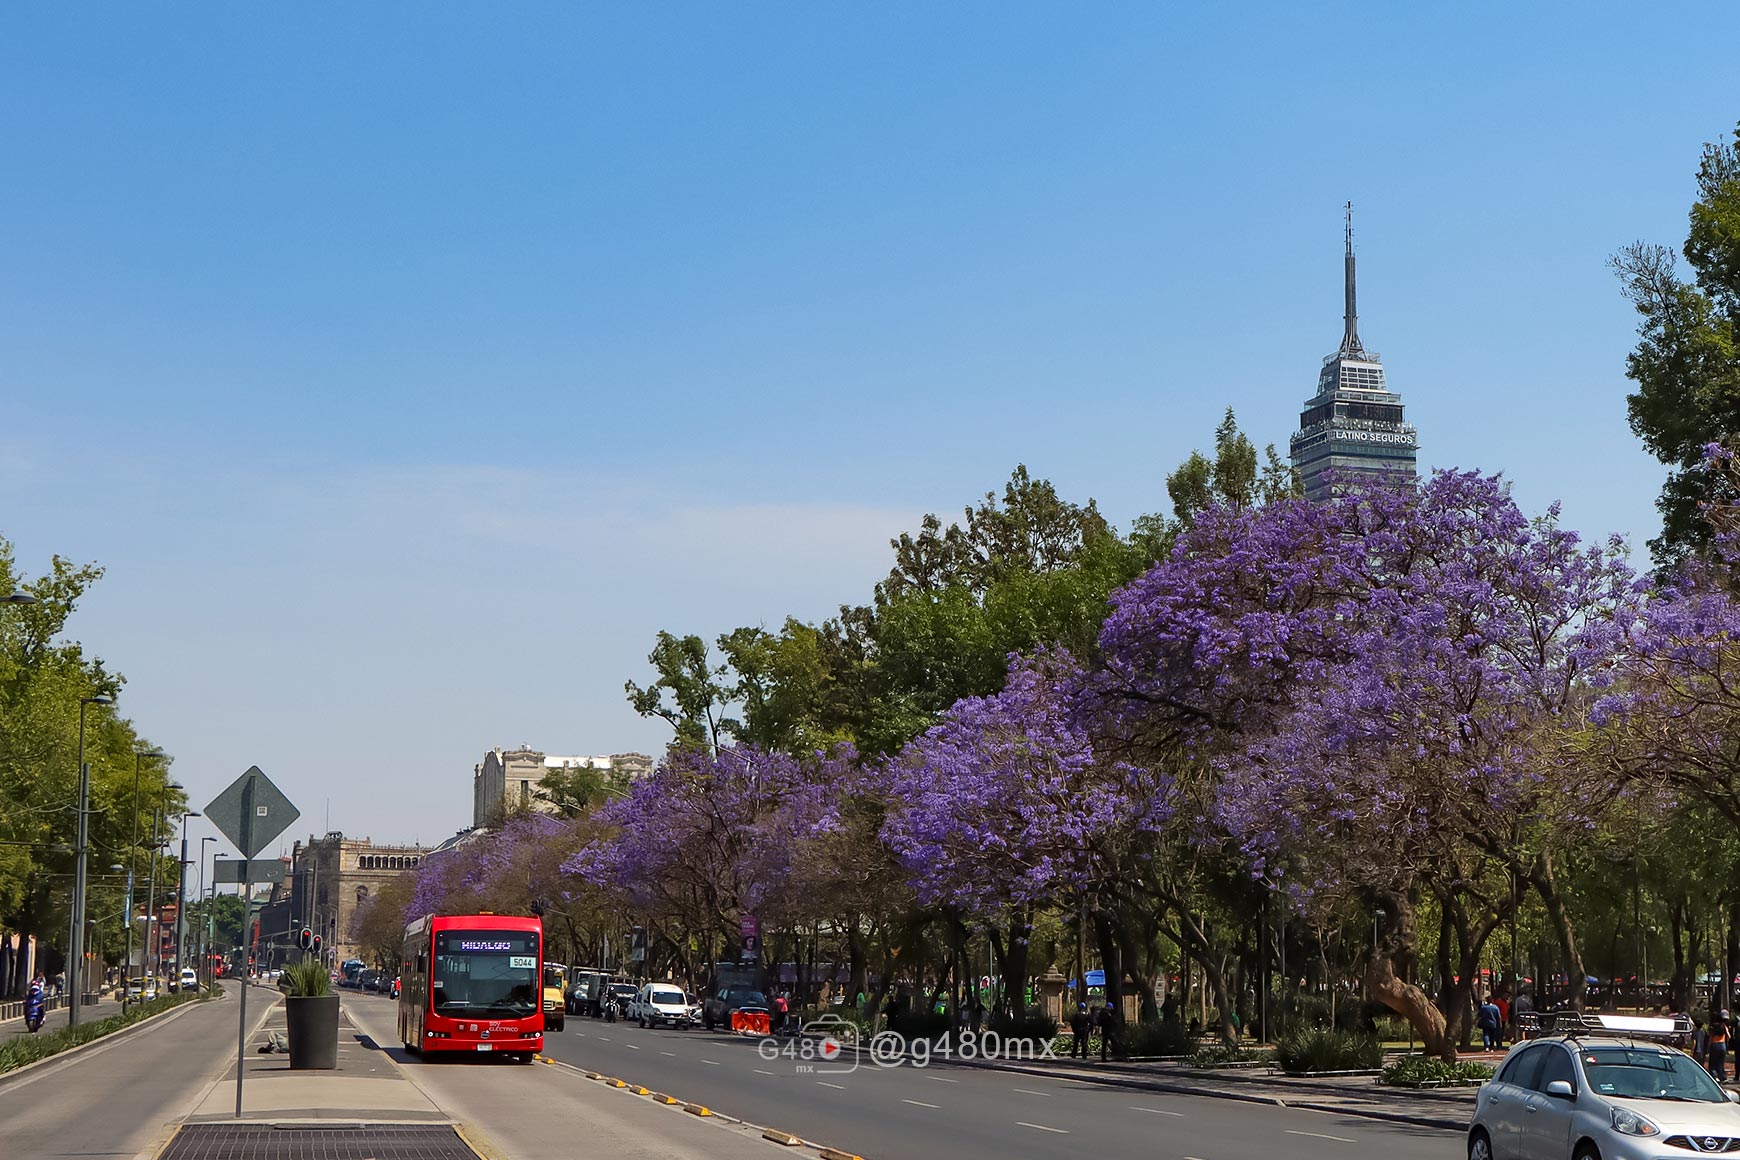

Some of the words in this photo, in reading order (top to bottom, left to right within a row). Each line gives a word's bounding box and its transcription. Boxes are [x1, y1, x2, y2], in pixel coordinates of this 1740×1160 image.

[1336, 431, 1367, 440] LATINO
[1369, 433, 1413, 443] SEGUROS
[461, 941, 511, 950] HIDALGO
[513, 958, 532, 967] 5044
